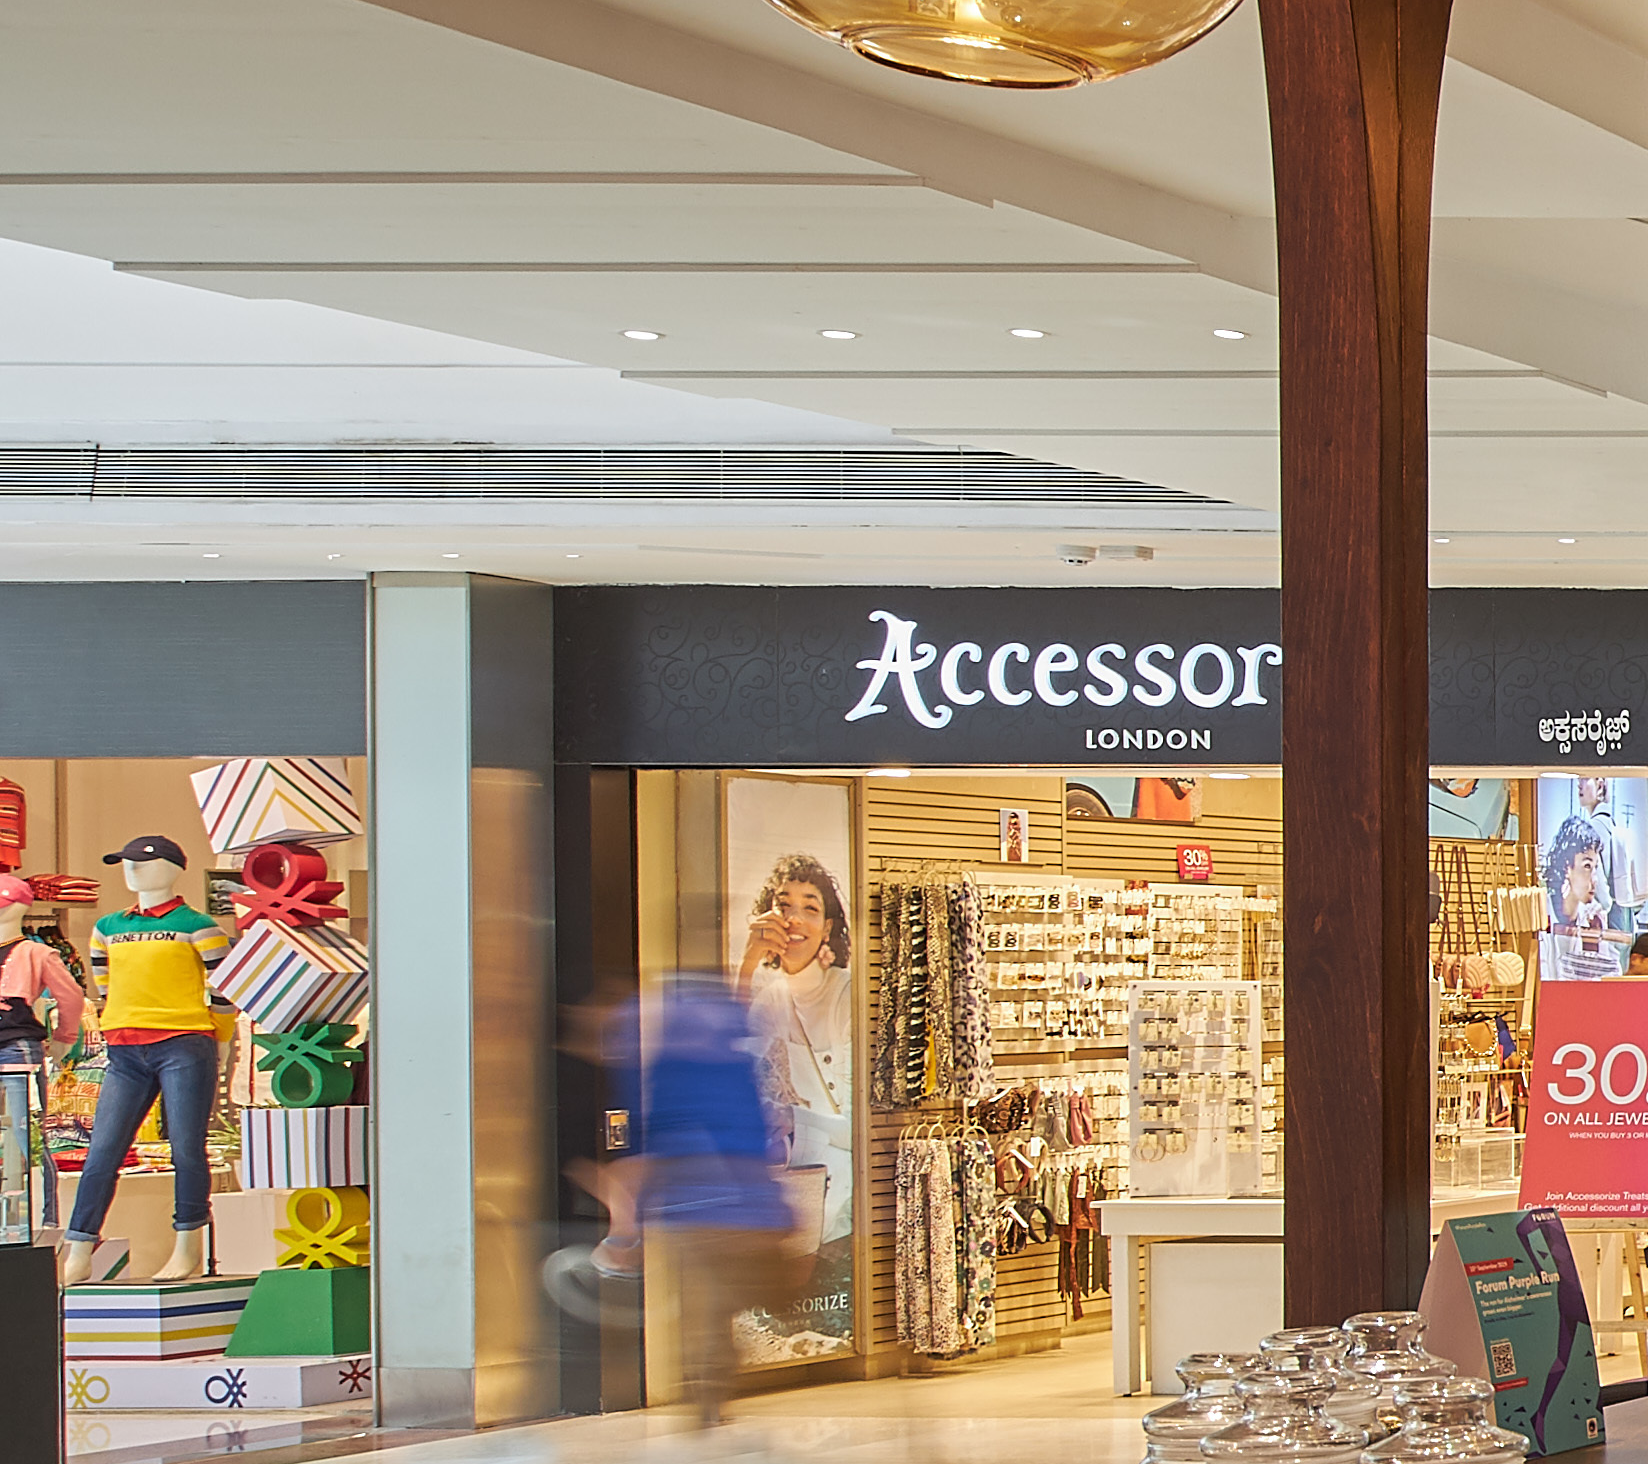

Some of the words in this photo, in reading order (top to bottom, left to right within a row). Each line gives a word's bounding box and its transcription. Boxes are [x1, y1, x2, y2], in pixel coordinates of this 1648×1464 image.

[1085, 729, 1212, 751] LONDON
[111, 930, 177, 945] BENETTON
[1544, 1112, 1570, 1126] ON
[1573, 1112, 1603, 1126] ALL
[1545, 1191, 1564, 1201] Join
[1565, 1191, 1621, 1201] Accessorize
[1590, 1202, 1629, 1212] discount
[1630, 1202, 1641, 1212] all
[1475, 1280, 1507, 1295] Forum
[1508, 1272, 1540, 1290] Purple
[1540, 1271, 1560, 1284] Run
